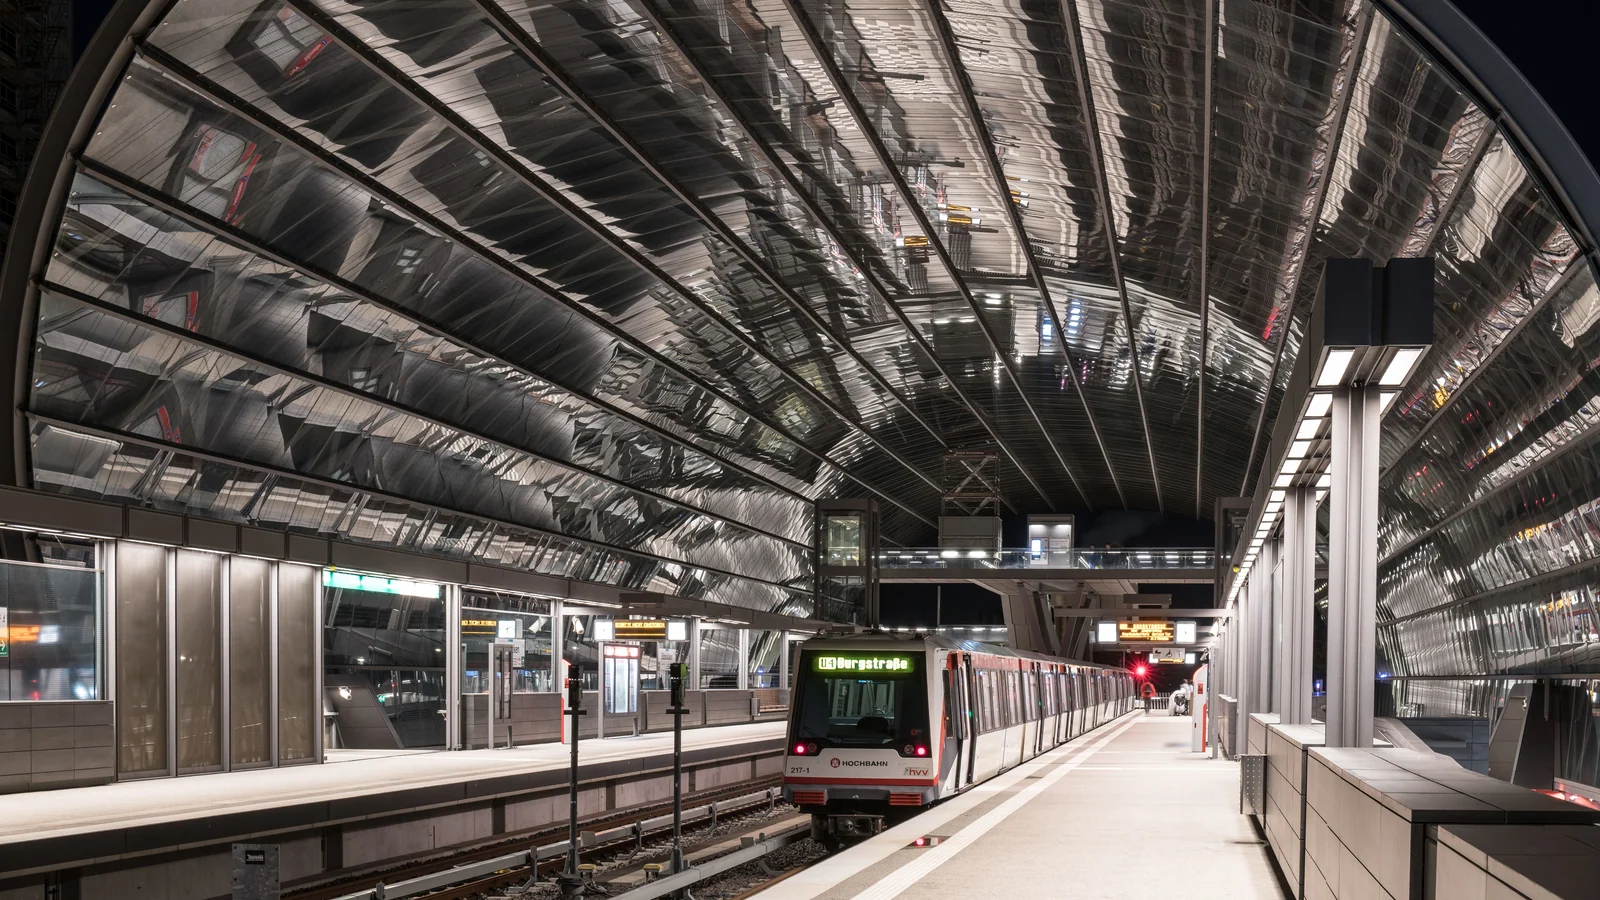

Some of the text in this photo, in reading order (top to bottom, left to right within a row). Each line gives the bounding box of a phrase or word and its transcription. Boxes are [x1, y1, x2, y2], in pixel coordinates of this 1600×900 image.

[820, 657, 908, 670] U4 Burgstraße
[909, 767, 929, 776] hvv
